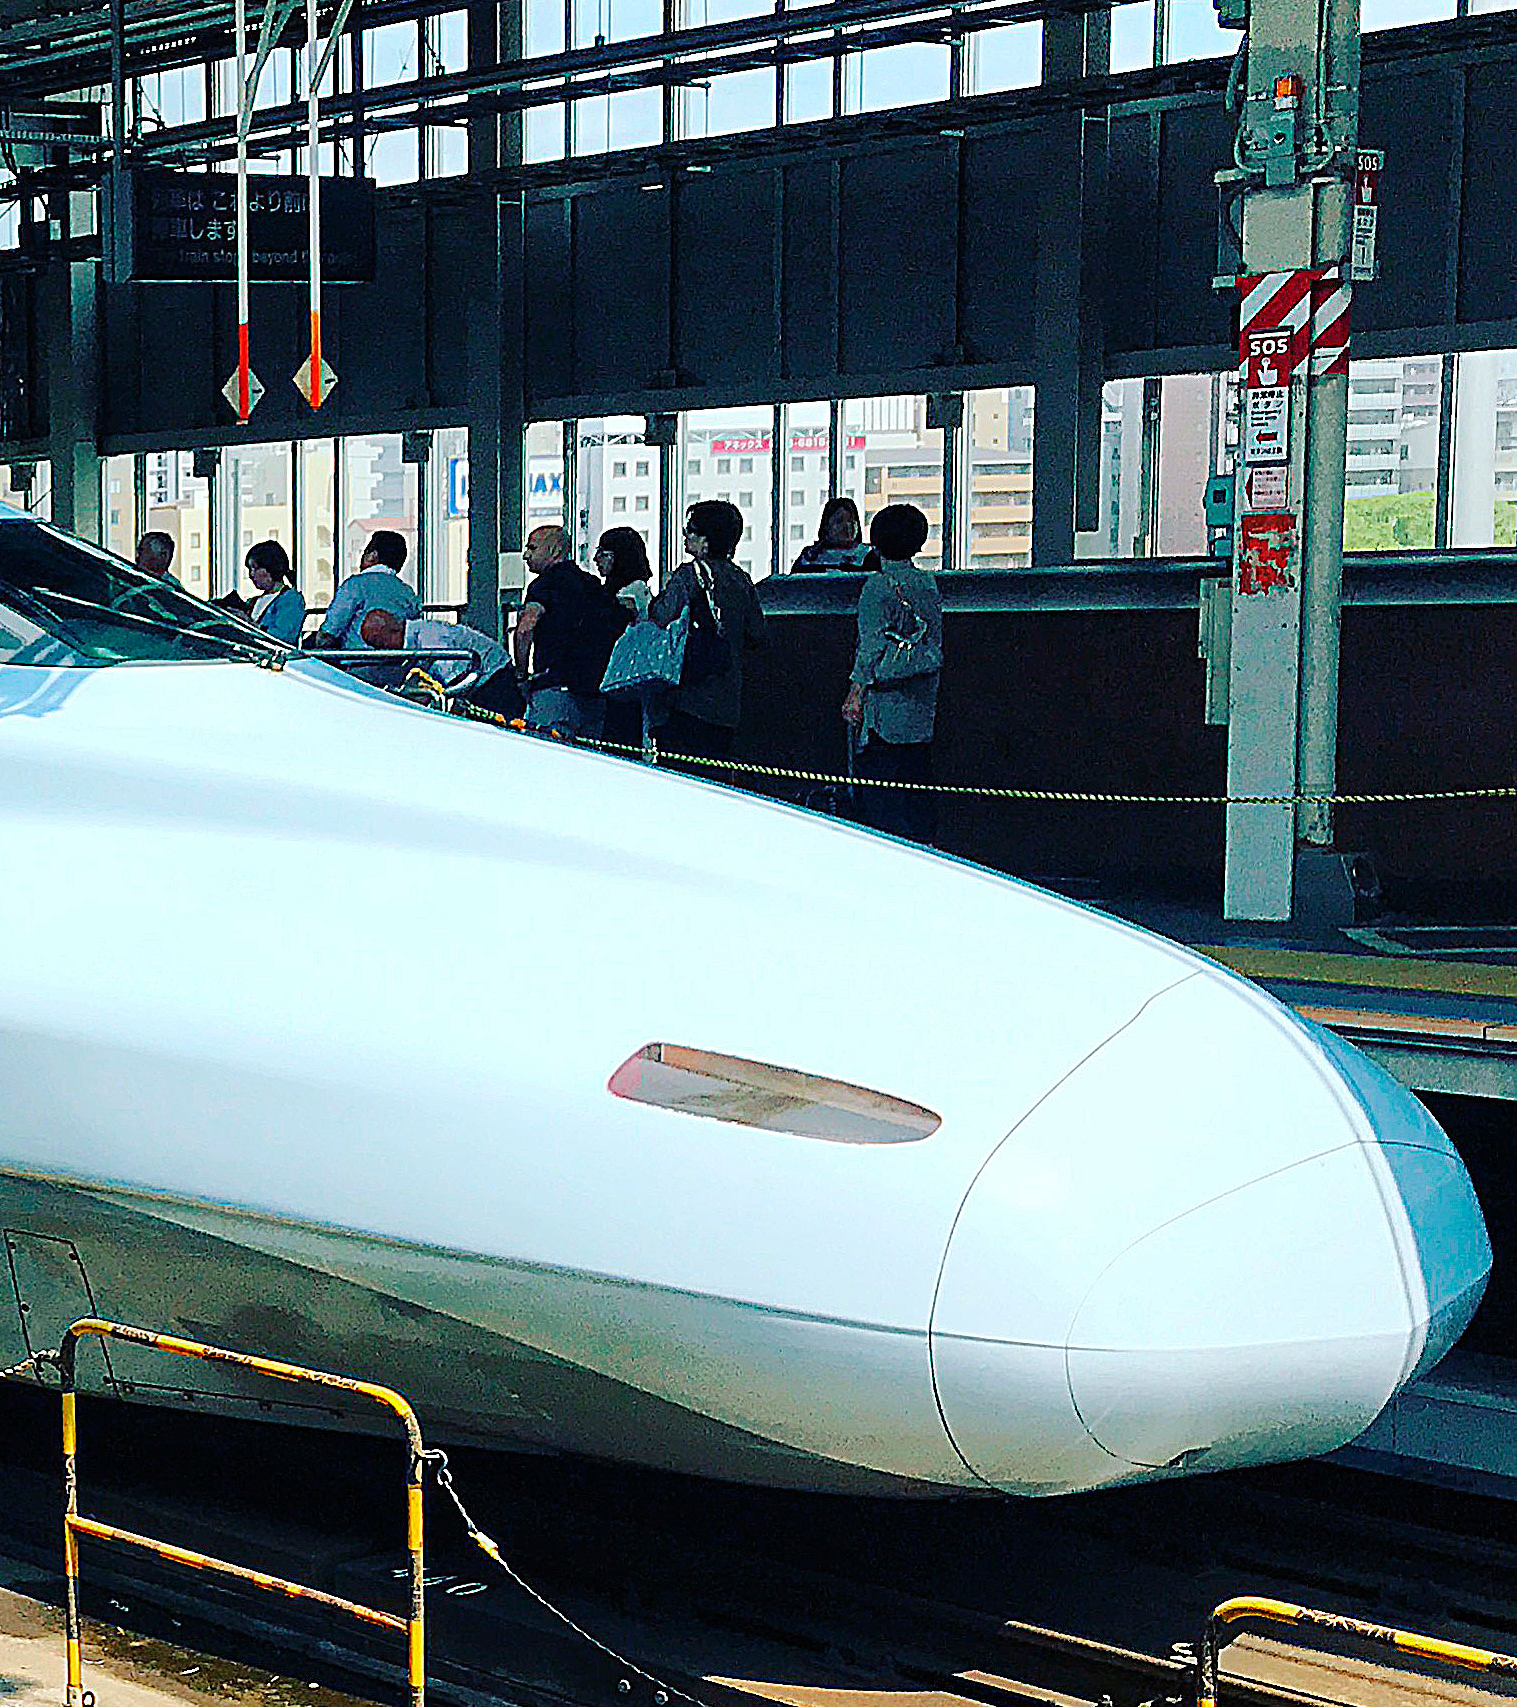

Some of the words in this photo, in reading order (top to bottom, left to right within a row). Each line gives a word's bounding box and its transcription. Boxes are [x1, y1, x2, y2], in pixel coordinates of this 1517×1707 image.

[1358, 156, 1378, 171] SOS
[251, 249, 298, 266] beyond
[1250, 338, 1288, 356] SOS
